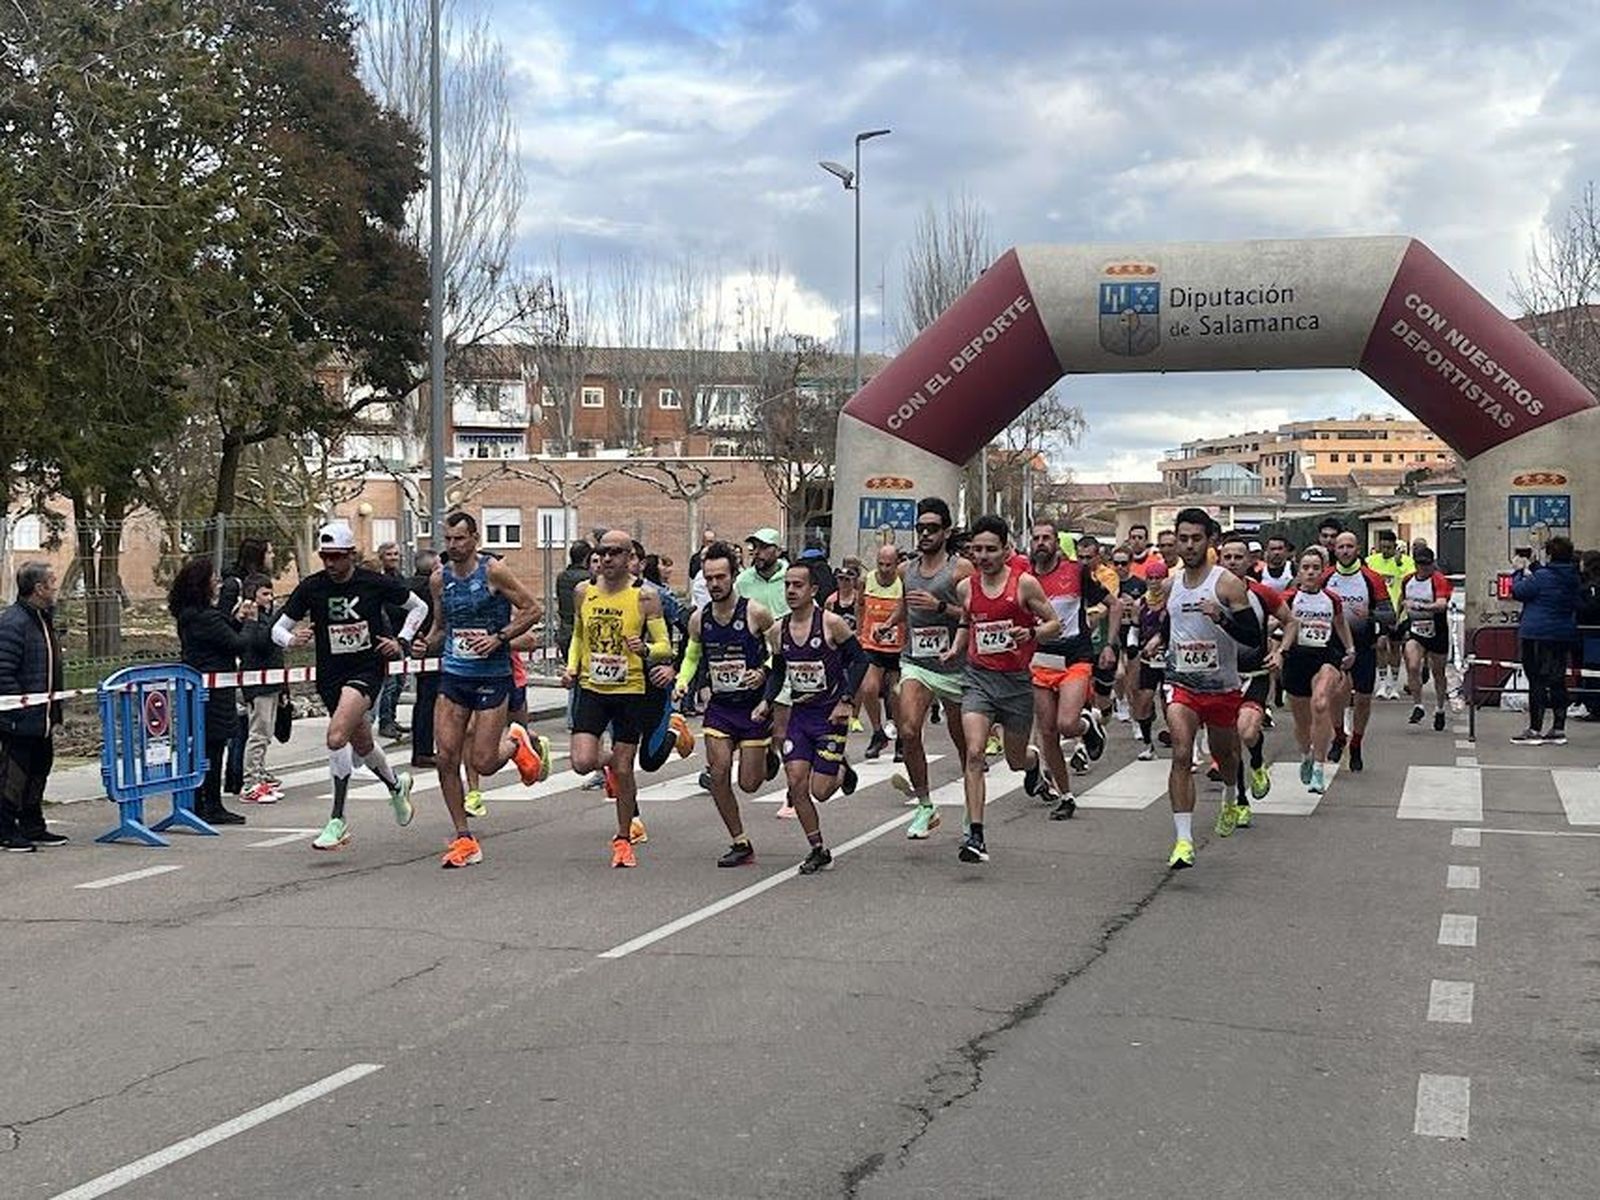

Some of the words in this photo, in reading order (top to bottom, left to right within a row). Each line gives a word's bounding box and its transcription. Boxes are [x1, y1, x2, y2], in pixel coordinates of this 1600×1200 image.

[1169, 283, 1294, 313] Diputación
[1169, 321, 1190, 337] de
[1199, 314, 1320, 336] Salamanca
[886, 392, 928, 430] CON
[924, 372, 952, 396] EL
[949, 295, 1032, 374] DEPORTE
[1404, 293, 1447, 332] CON
[1444, 328, 1544, 416] NUESTROS
[1391, 319, 1515, 429] DEPORTISTAS
[918, 636, 941, 649] 441
[1183, 651, 1209, 664] 466
[595, 665, 620, 677] 447
[717, 671, 740, 683] 435
